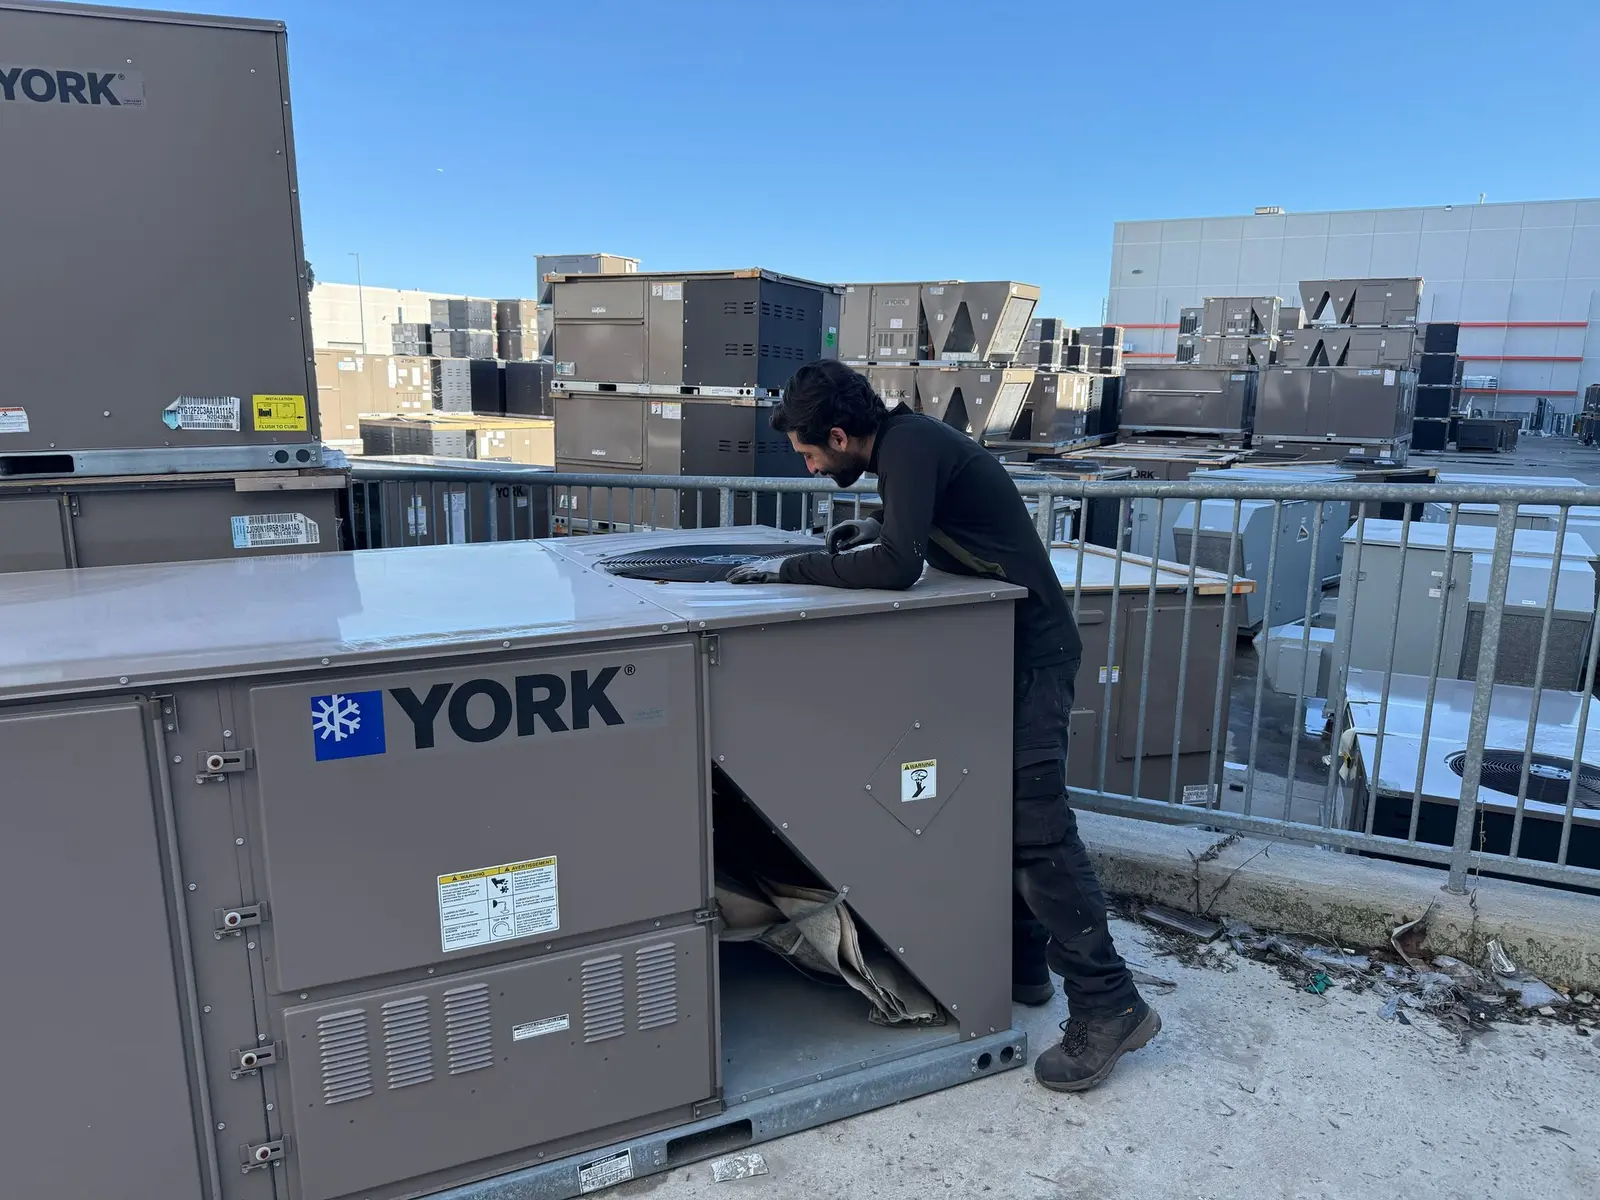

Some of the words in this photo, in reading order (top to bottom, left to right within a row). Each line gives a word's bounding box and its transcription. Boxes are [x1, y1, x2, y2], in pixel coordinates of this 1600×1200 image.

[1133, 470, 1155, 479] ORK
[389, 665, 625, 750] YORK
[910, 761, 934, 769] WARNING
[511, 859, 552, 871] AVERTISSEMENT
[460, 871, 485, 880] WARNING
